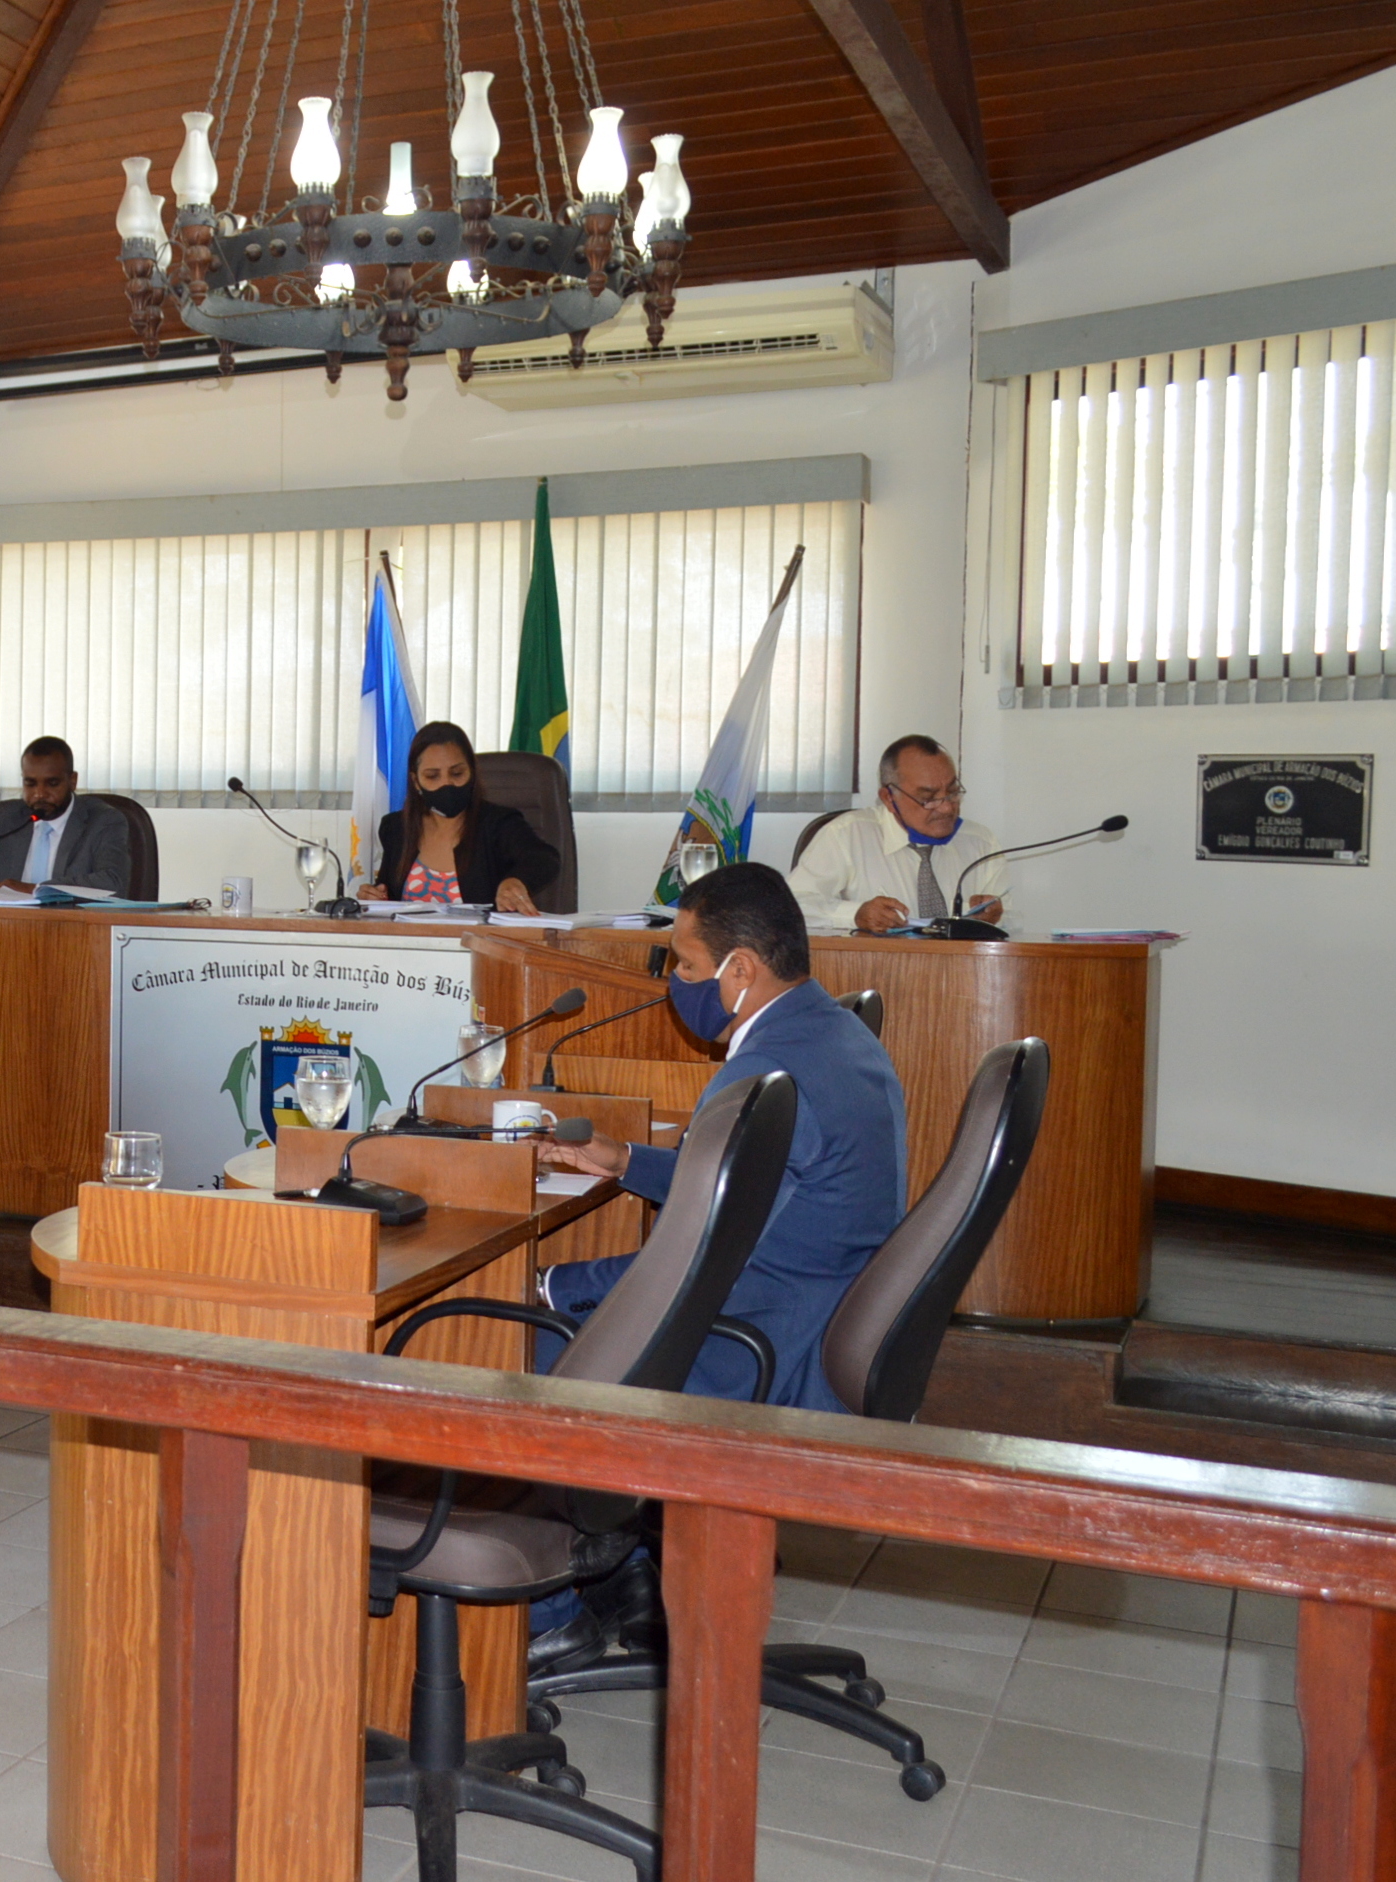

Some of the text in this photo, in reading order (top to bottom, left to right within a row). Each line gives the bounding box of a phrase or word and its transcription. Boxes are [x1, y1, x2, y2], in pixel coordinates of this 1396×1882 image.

[1255, 826, 1303, 835] VEREADOR
[131, 958, 471, 1006] Câmara Municipal de Armação dos Búz
[238, 993, 379, 1012] Estado do Rio de Janeiro
[272, 1046, 302, 1054] ARMAÇÃO
